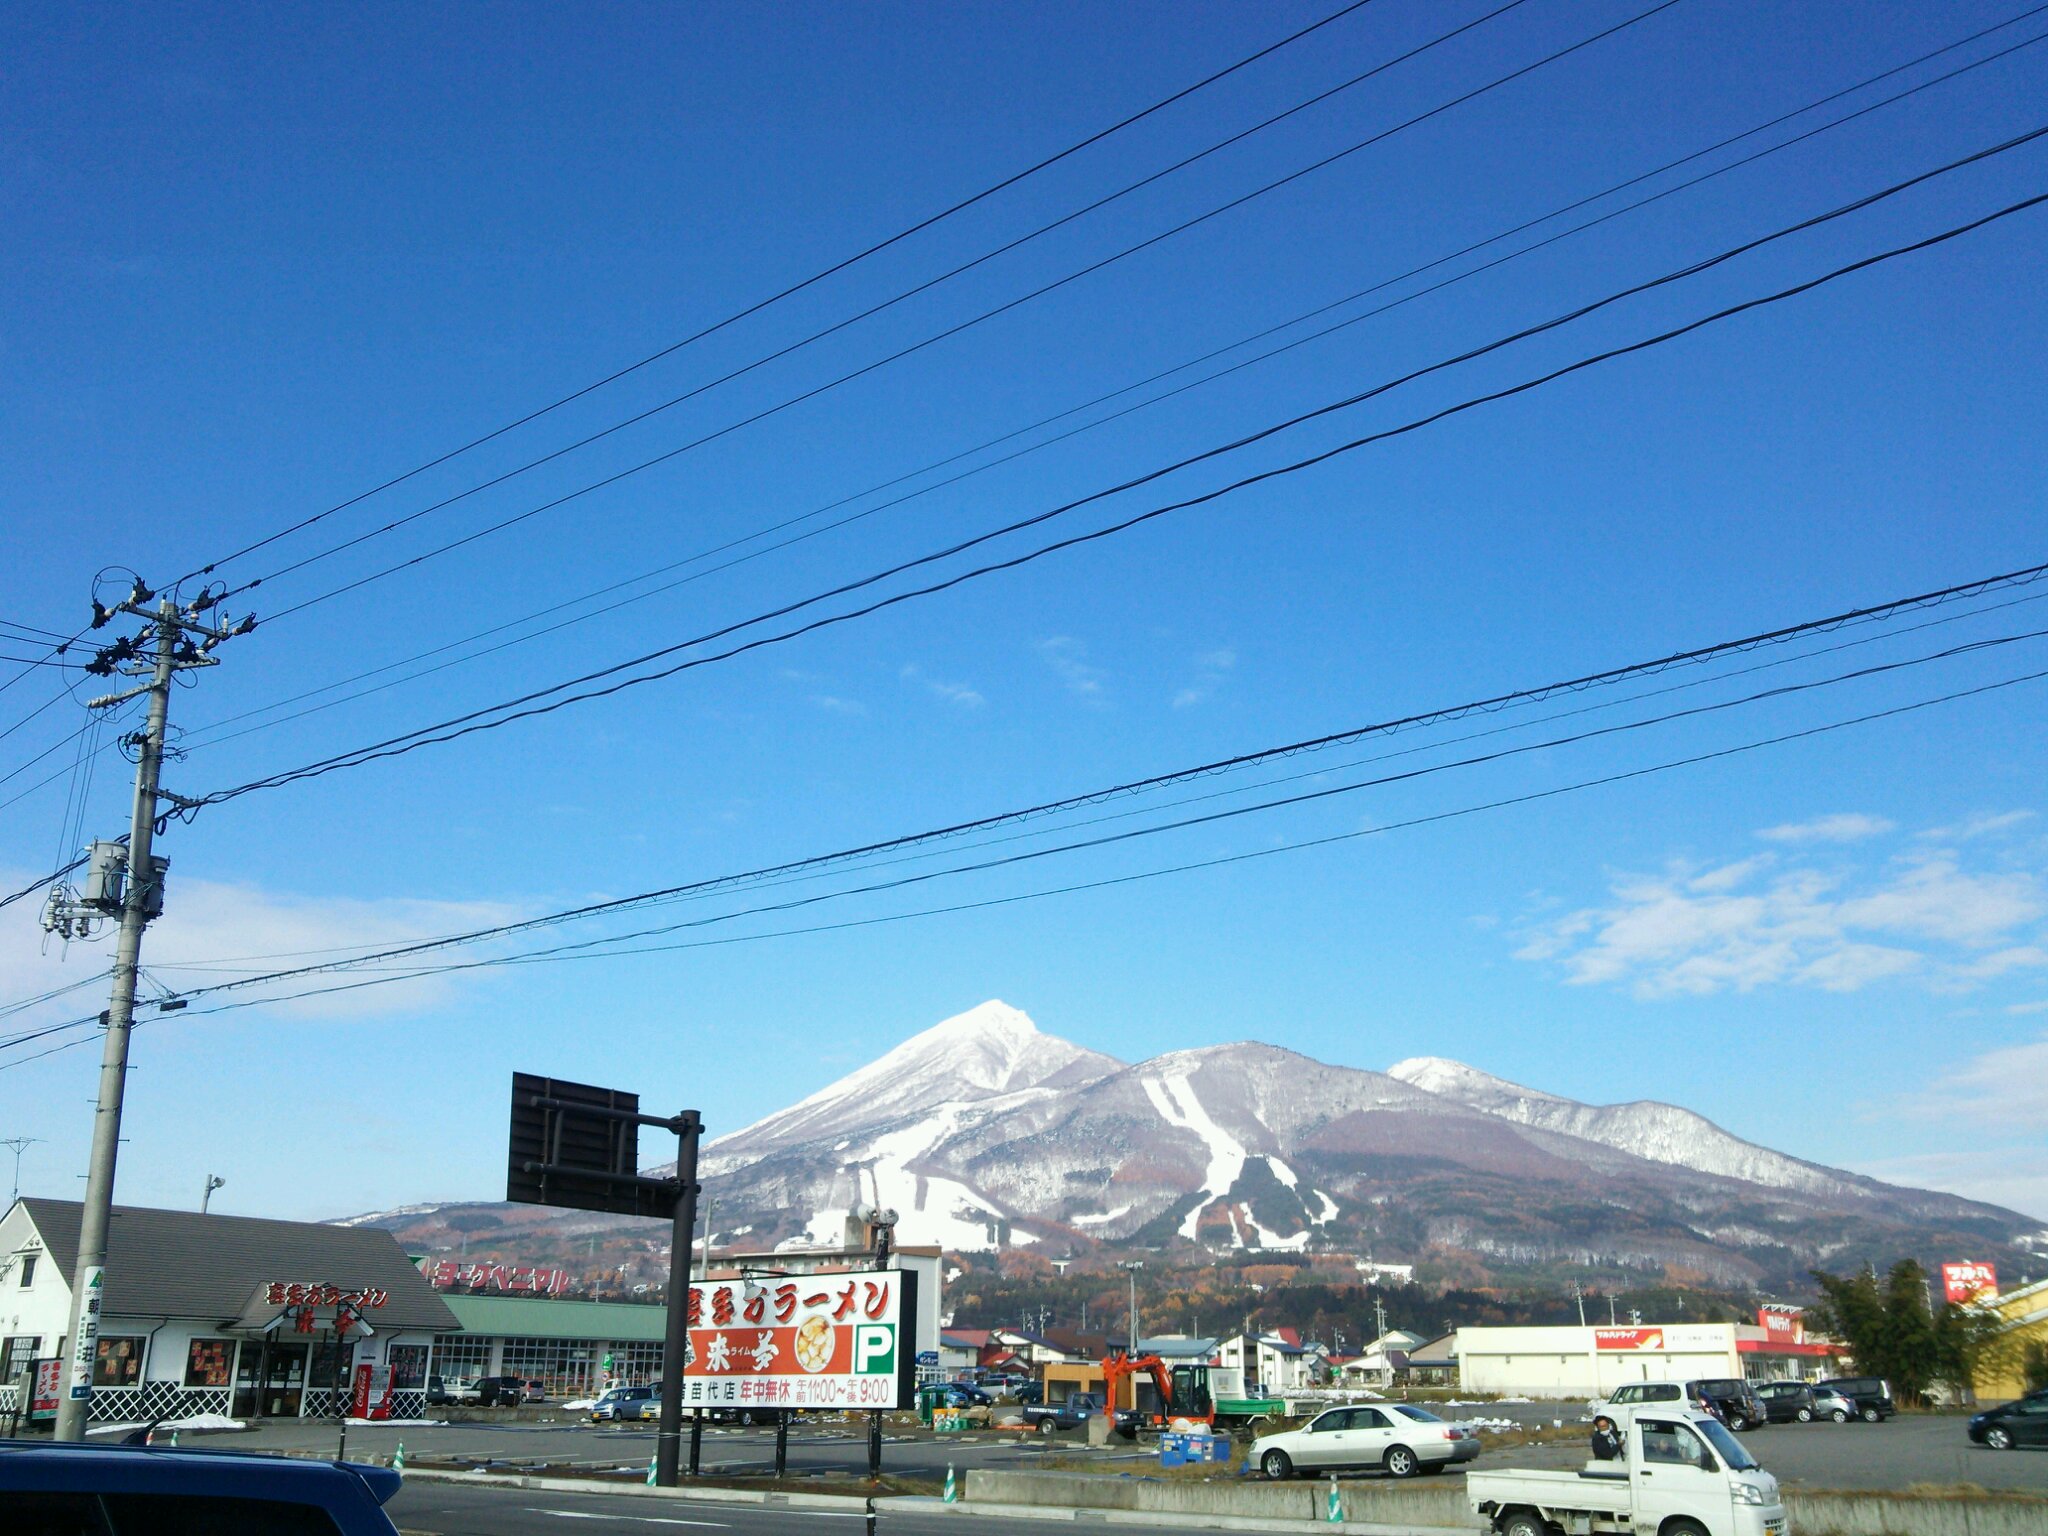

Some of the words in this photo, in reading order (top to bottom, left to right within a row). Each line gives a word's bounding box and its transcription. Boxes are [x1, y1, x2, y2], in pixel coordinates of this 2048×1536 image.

[431, 1259, 570, 1293] ヨークベニマル
[1946, 1266, 1993, 1280] ツルハ
[264, 1282, 389, 1308] 喜多方ラーメン
[687, 1281, 890, 1326] 喜多方ラーメン
[81, 1298, 100, 1363] 朝日荘
[731, 1345, 751, 1357] ライム
[857, 1326, 893, 1372] P
[740, 1378, 791, 1402] 年中無休
